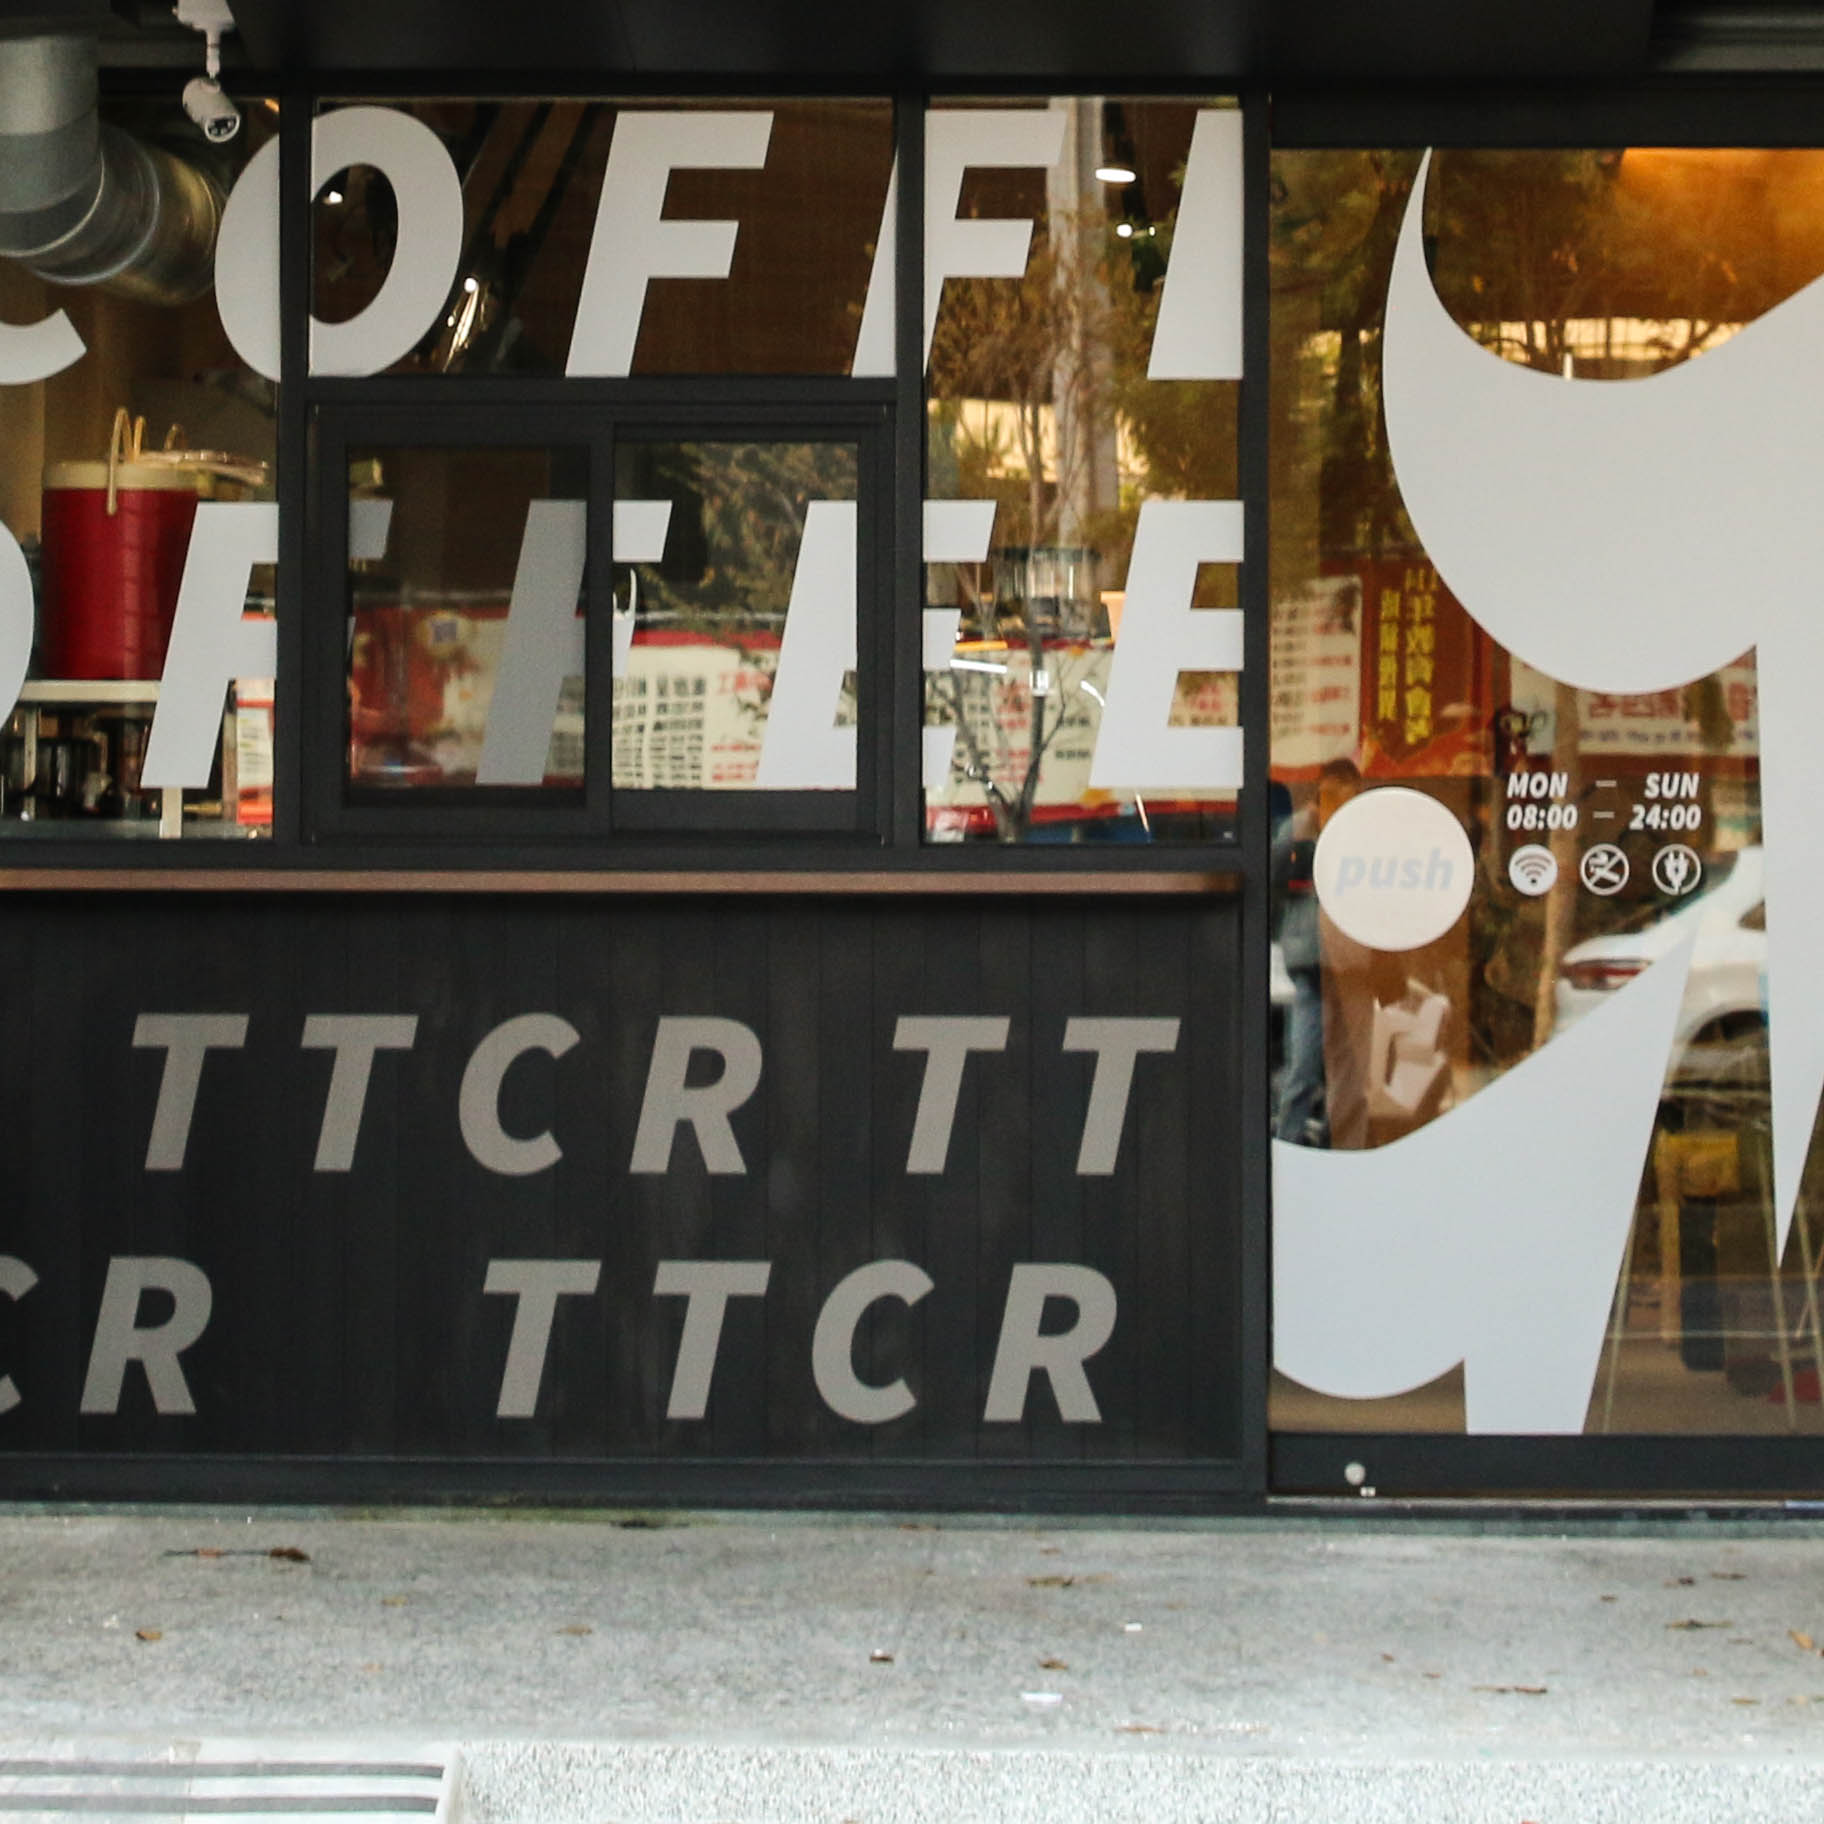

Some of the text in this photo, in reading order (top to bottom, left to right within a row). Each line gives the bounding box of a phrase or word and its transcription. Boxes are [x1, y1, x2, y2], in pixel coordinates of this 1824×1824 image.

[1507, 772, 1701, 800] MON SUN
[1507, 804, 1702, 831] 08:00 24:00
[1335, 847, 1455, 897] push
